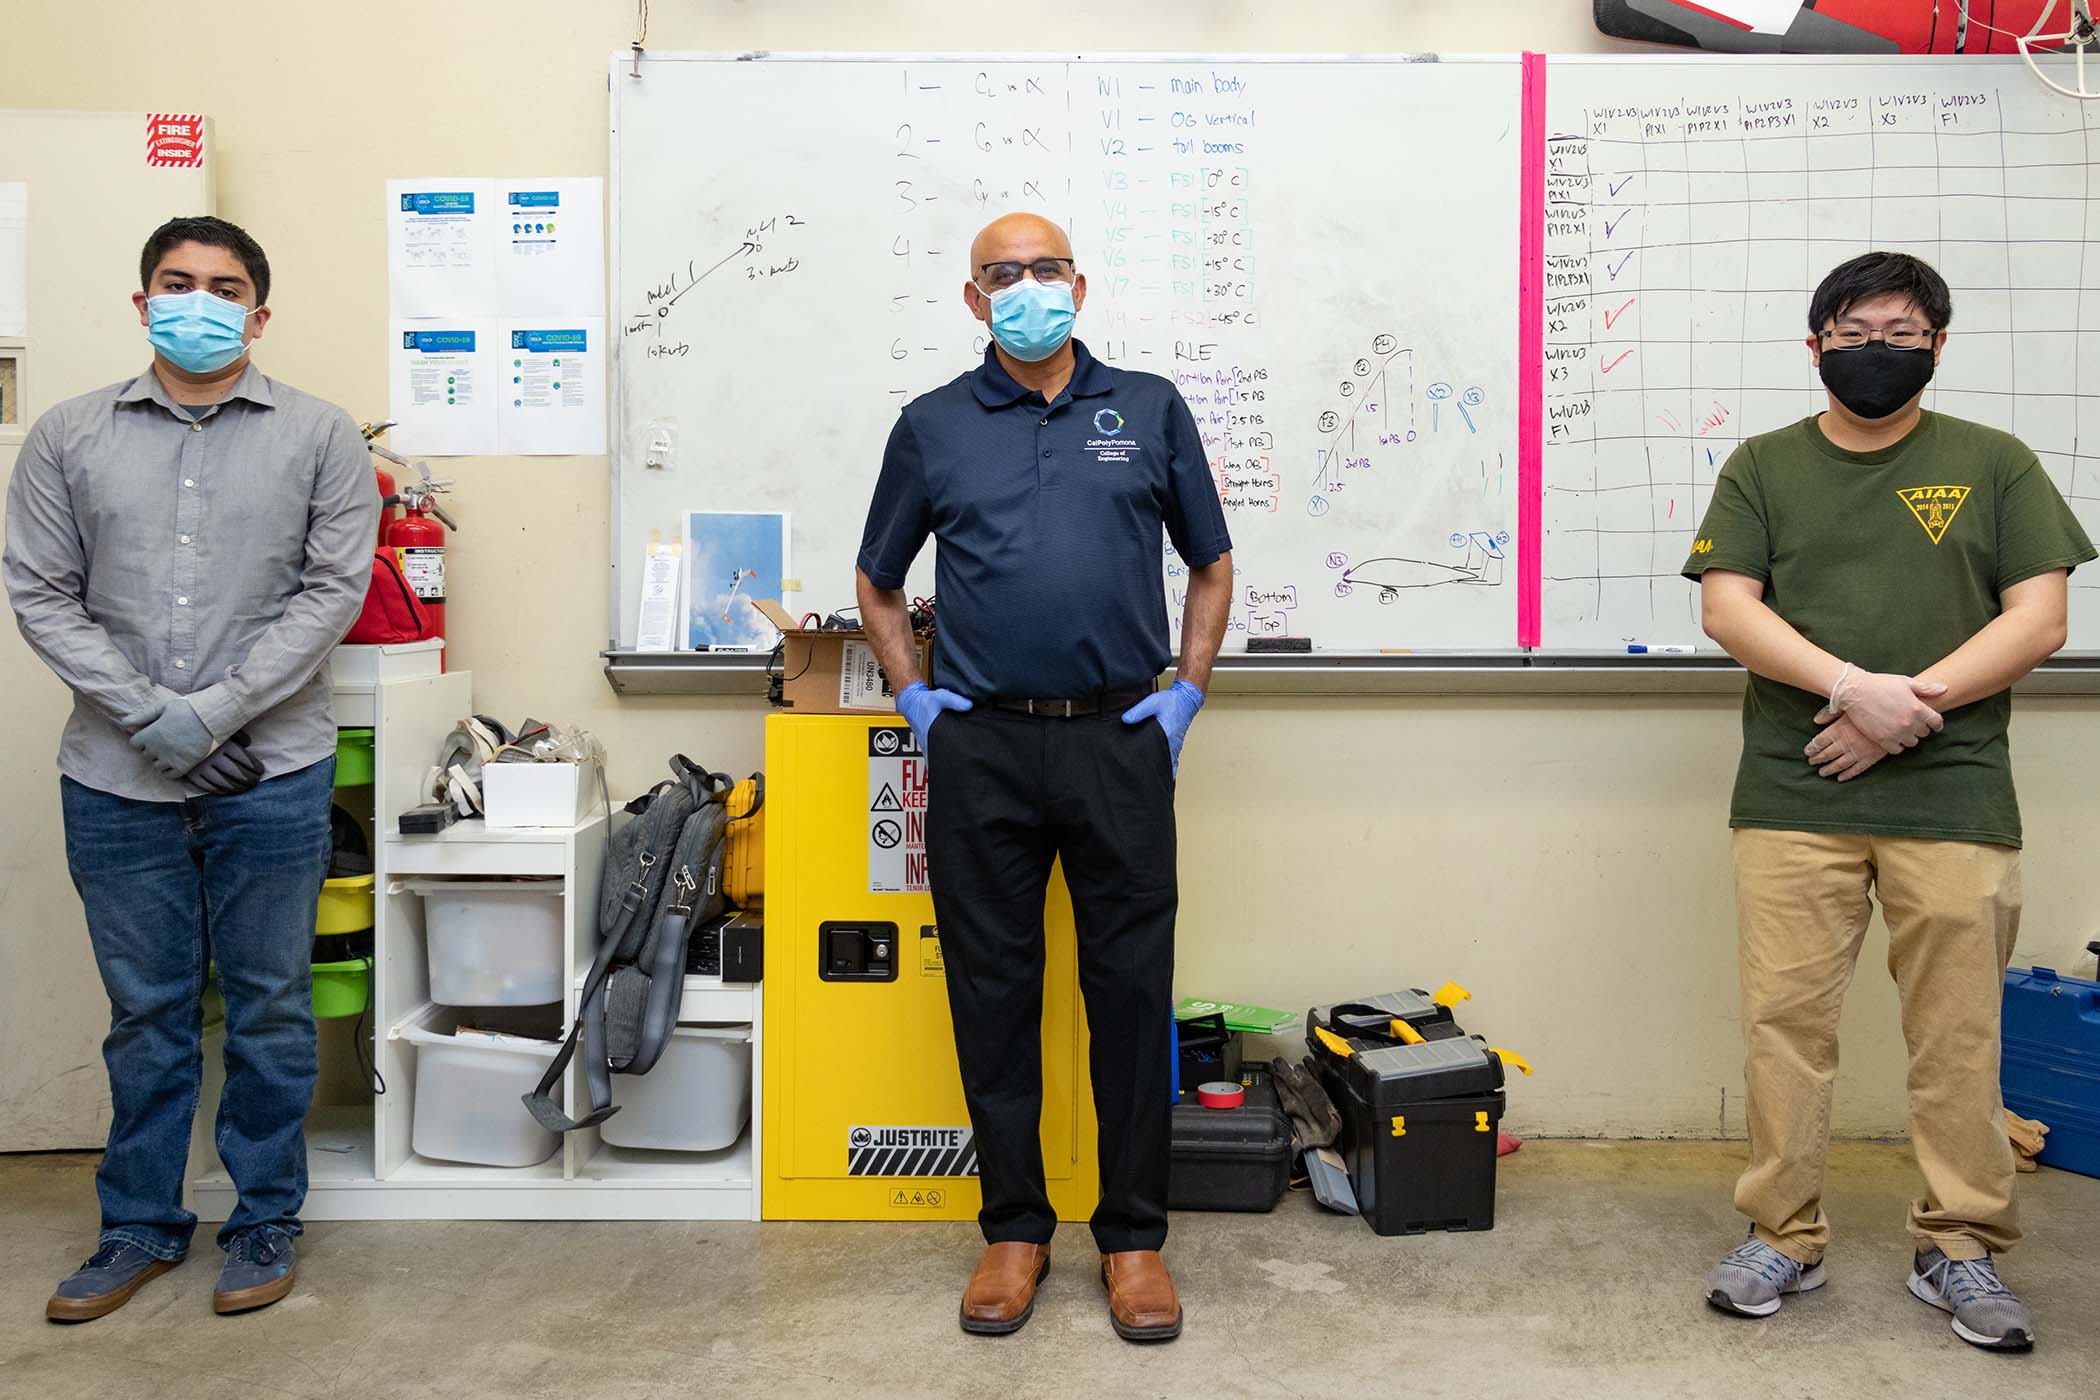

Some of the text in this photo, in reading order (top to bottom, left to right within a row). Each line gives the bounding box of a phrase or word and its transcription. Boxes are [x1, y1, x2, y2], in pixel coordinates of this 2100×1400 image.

[1170, 77, 1204, 95] main
[1211, 71, 1247, 99] body
[1812, 114, 1830, 130] X2
[1880, 113, 1898, 127] X3
[1941, 112, 1959, 126] F1
[158, 124, 192, 136] FIRE
[157, 148, 193, 158] INSIDE
[1100, 137, 1128, 156] V2
[1202, 139, 1244, 155] booms
[892, 232, 911, 272] 4
[1548, 320, 1569, 334] X2
[890, 337, 909, 361] 6
[1549, 366, 1569, 382] X3
[1550, 424, 1571, 440] F1
[1909, 488, 1962, 501] AIAA
[865, 661, 876, 691] UN3480
[873, 1129, 958, 1147] JUSTRITE
